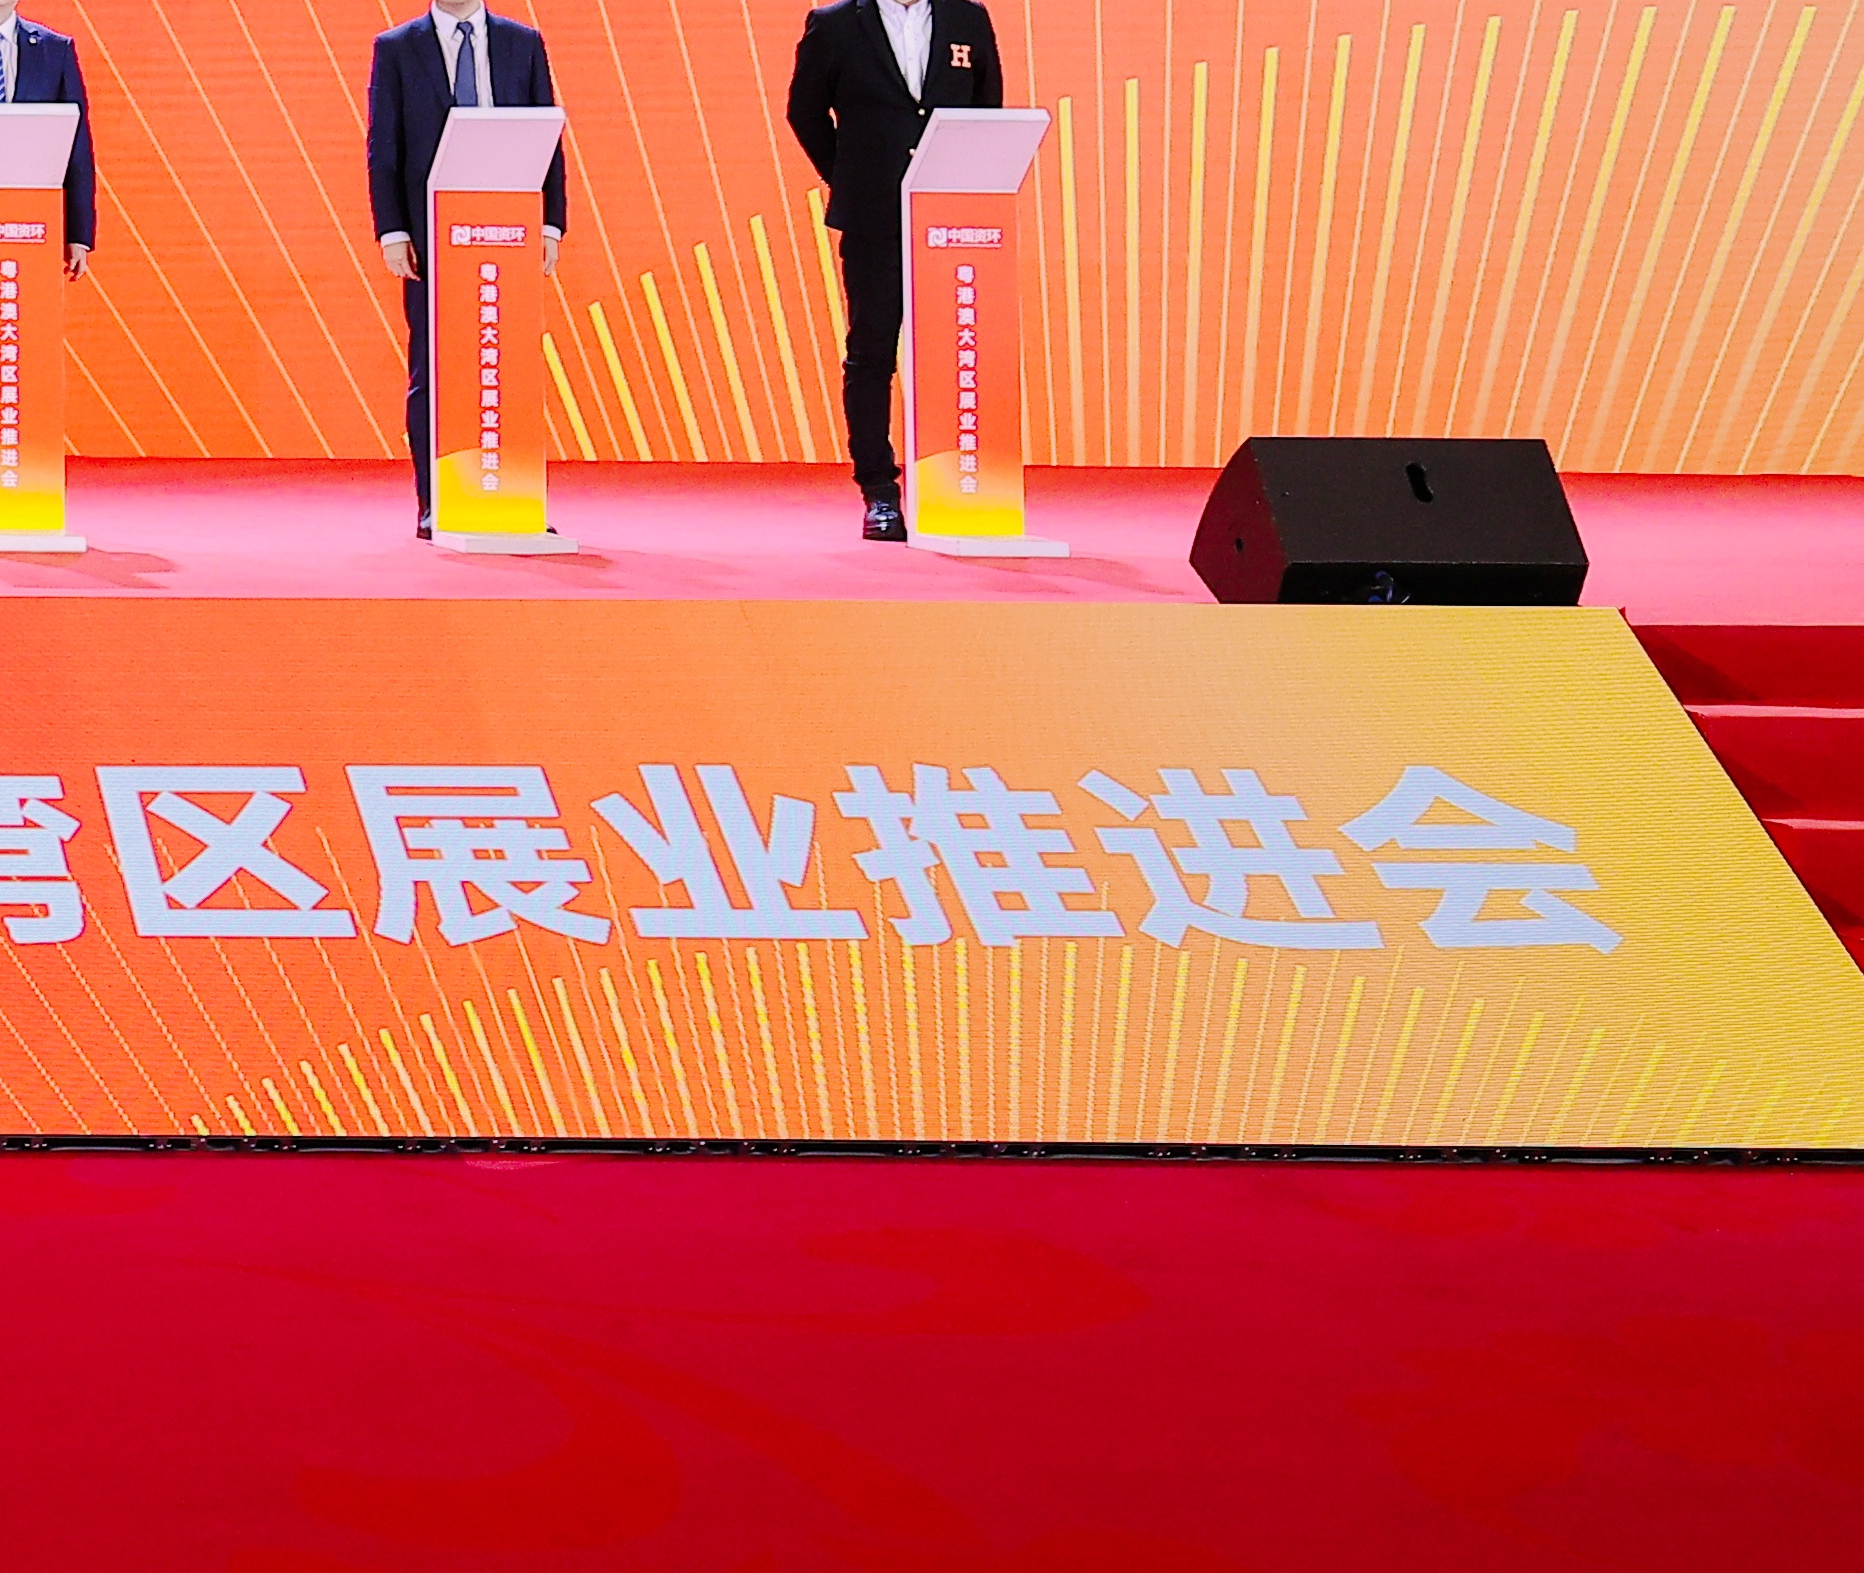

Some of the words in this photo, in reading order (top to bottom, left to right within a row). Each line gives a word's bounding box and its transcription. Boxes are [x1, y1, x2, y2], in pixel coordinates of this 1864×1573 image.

[950, 44, 972, 68] H
[479, 263, 500, 492] 粤港澳大湾区展业推进会
[955, 264, 979, 495] 粤港澳大湾区展业推进会
